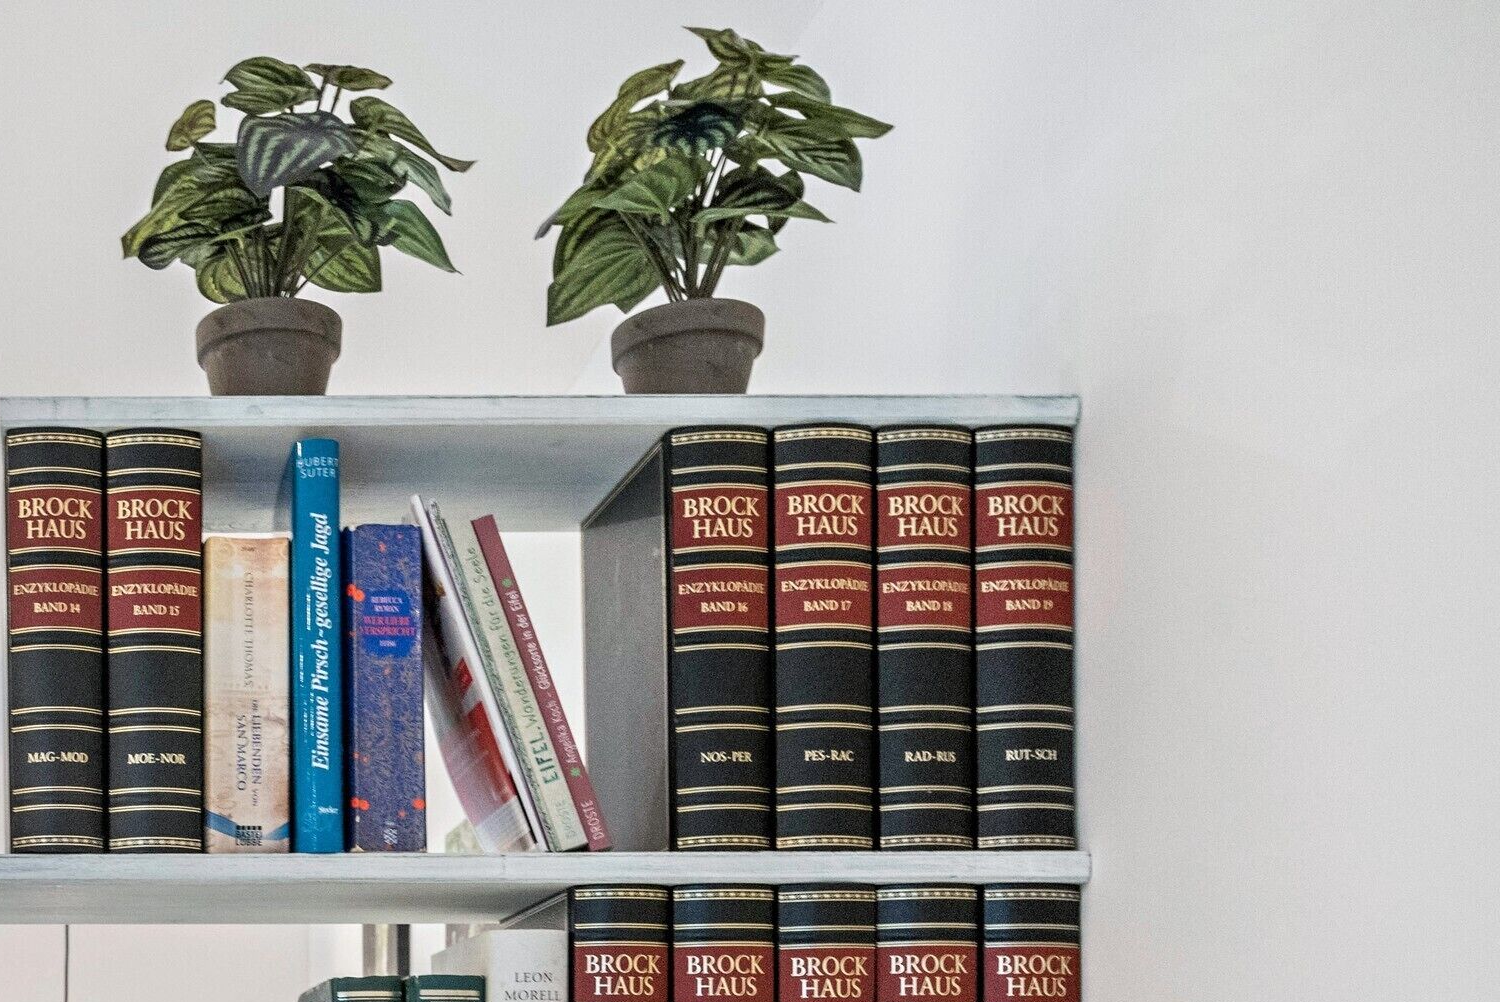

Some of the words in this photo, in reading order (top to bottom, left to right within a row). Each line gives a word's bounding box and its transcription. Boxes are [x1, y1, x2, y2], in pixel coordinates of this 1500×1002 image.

[300, 468, 336, 479] SUTER
[18, 498, 92, 518] BROCK
[988, 497, 1064, 516] BROCK
[26, 520, 86, 539] HAUS
[309, 512, 329, 555] Jagd
[998, 517, 1058, 537] HAUS
[466, 547, 488, 584] Seele
[13, 582, 98, 597] ENZYKLOPÄDIE
[482, 587, 495, 607] die
[34, 602, 66, 614] BAND
[69, 602, 80, 614] 14
[505, 590, 523, 612] Eifel
[516, 613, 530, 629] der
[237, 714, 245, 739] SAN
[310, 696, 330, 771] Einsame
[250, 714, 262, 785] LIEBENDEN
[557, 725, 577, 765] Angelika
[1006, 749, 1057, 761] RUT-SCH
[28, 752, 88, 764] MAG-MOD
[236, 744, 246, 792] MARCO
[581, 799, 605, 841] DROSTE
[791, 957, 868, 977] BROCK
[515, 972, 553, 983] LEON
[504, 989, 562, 1001] MORELL
[800, 978, 861, 998] HAUS
